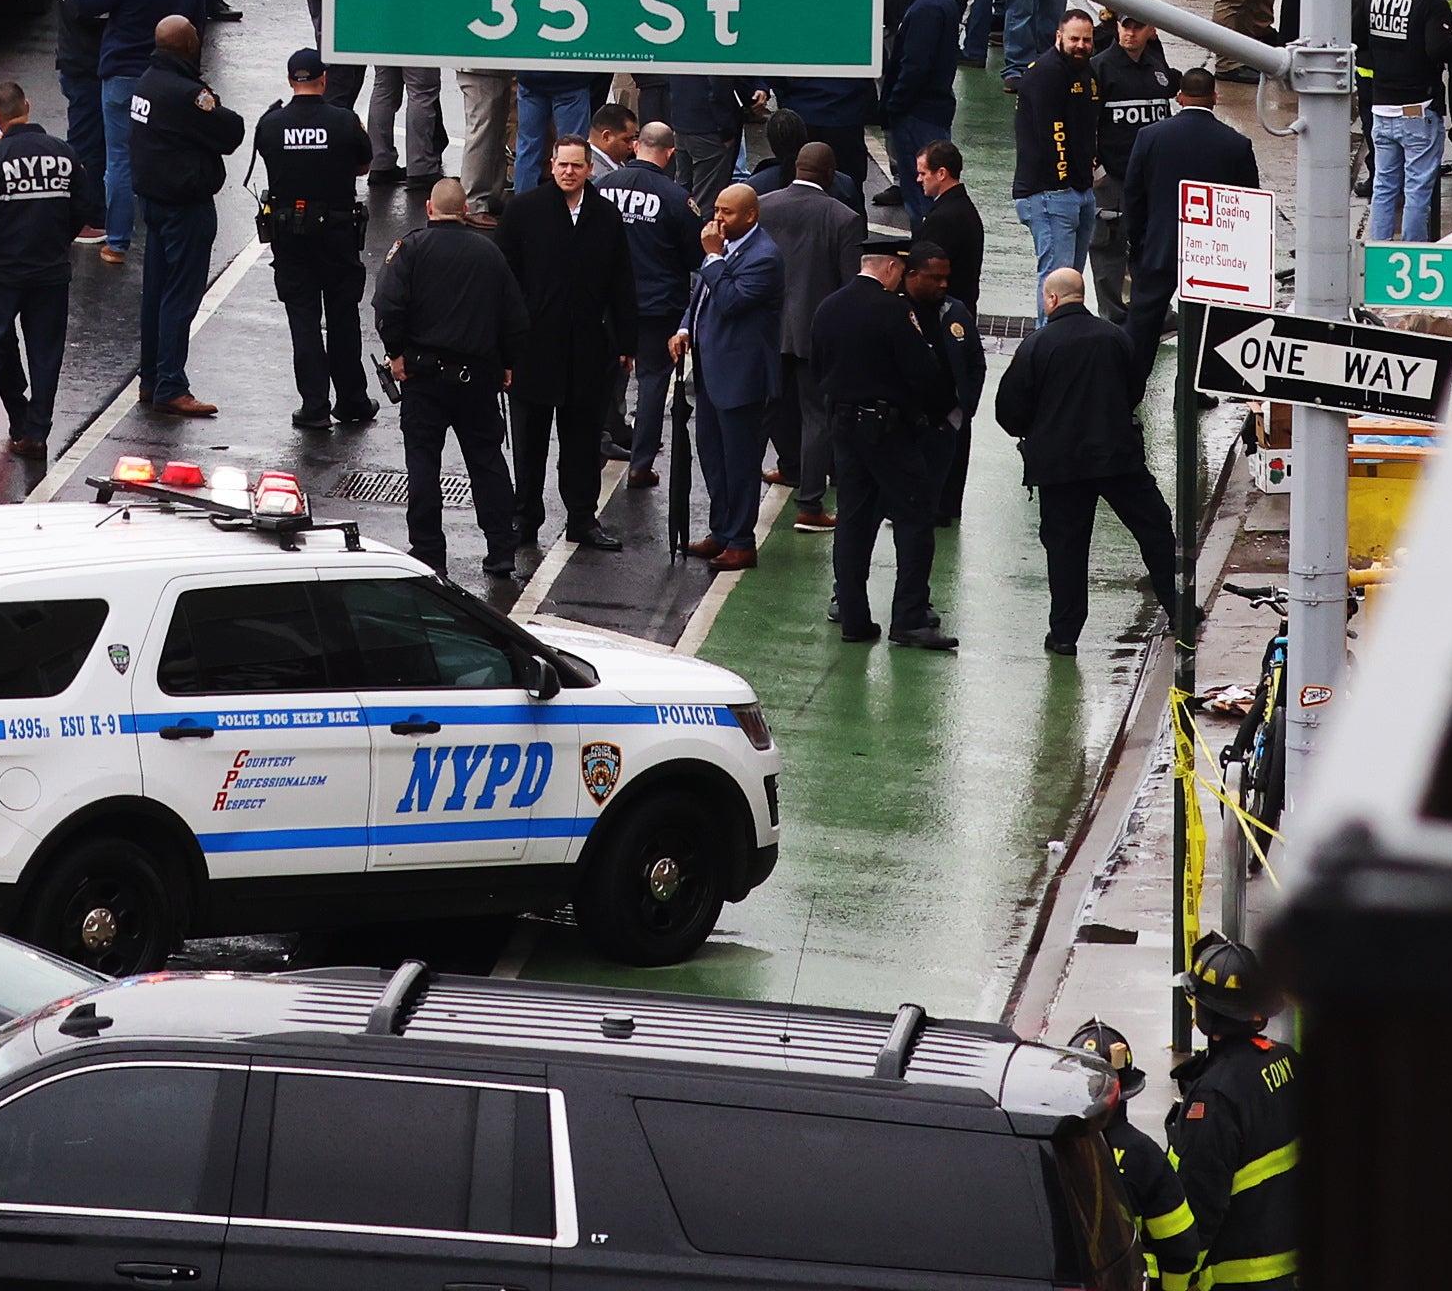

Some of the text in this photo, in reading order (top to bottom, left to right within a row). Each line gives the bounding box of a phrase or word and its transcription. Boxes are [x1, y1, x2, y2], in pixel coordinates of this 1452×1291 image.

[1369, 12, 1408, 34] POLICE
[284, 127, 328, 145] NYPD
[2, 155, 73, 182] NYPD
[7, 177, 72, 194] POLICE
[1216, 192, 1241, 206] Truck
[1216, 205, 1251, 221] Loading
[1216, 217, 1236, 232] Only
[1185, 251, 1248, 271] Except Sunday
[1241, 337, 1421, 393] ONE WAY
[8, 716, 42, 739] 4395
[60, 715, 84, 737] ESU
[90, 713, 116, 736] K-9
[217, 710, 359, 727] POLICE DOG KEEP BACK
[659, 705, 715, 727] POLICE
[233, 750, 297, 770] COURTESY
[222, 769, 329, 791] PROFESSIONALISM
[395, 740, 555, 814] NYPD
[212, 791, 267, 812] RESPECT
[591, 1233, 609, 1244] LT
